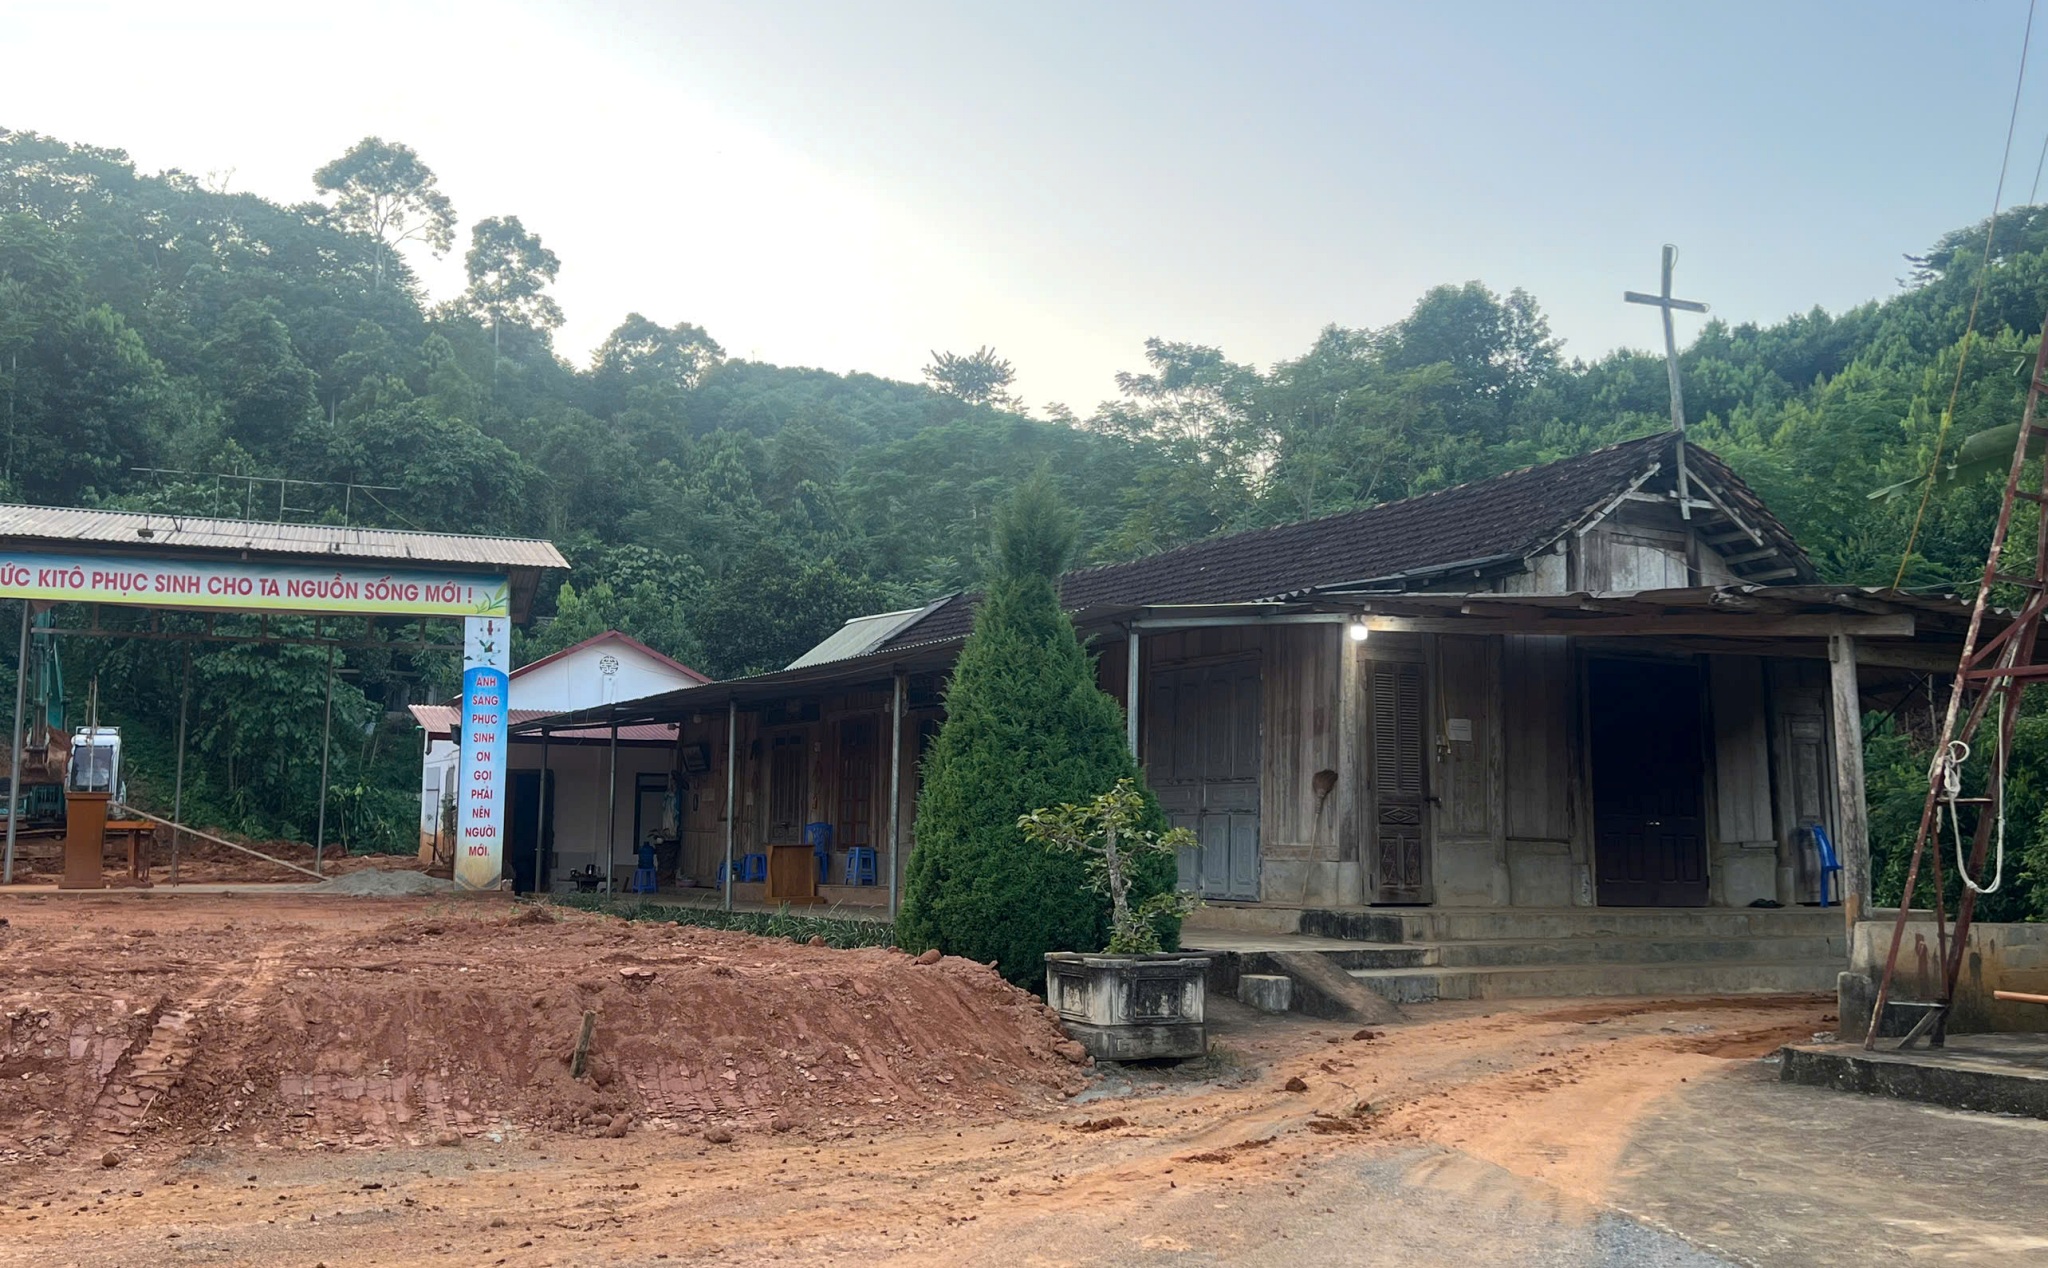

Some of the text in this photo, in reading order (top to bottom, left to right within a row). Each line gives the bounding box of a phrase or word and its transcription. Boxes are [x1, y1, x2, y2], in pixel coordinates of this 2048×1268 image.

[38, 565, 85, 589] KITÔ
[91, 572, 148, 596] PHỤC
[155, 574, 201, 594] SINH
[207, 576, 253, 596] CHO
[259, 578, 280, 597] TA
[287, 572, 358, 600] NGUỒN
[364, 576, 419, 602] SỐNG
[425, 581, 461, 603] MỚI
[472, 714, 498, 728] PHỤC
[473, 732, 495, 743] SINH
[476, 751, 491, 762] ƠN
[473, 770, 492, 784] GỌI
[471, 786, 493, 800] PHẢI
[472, 805, 490, 818] NÊN
[465, 825, 496, 838] NGƯỜI
